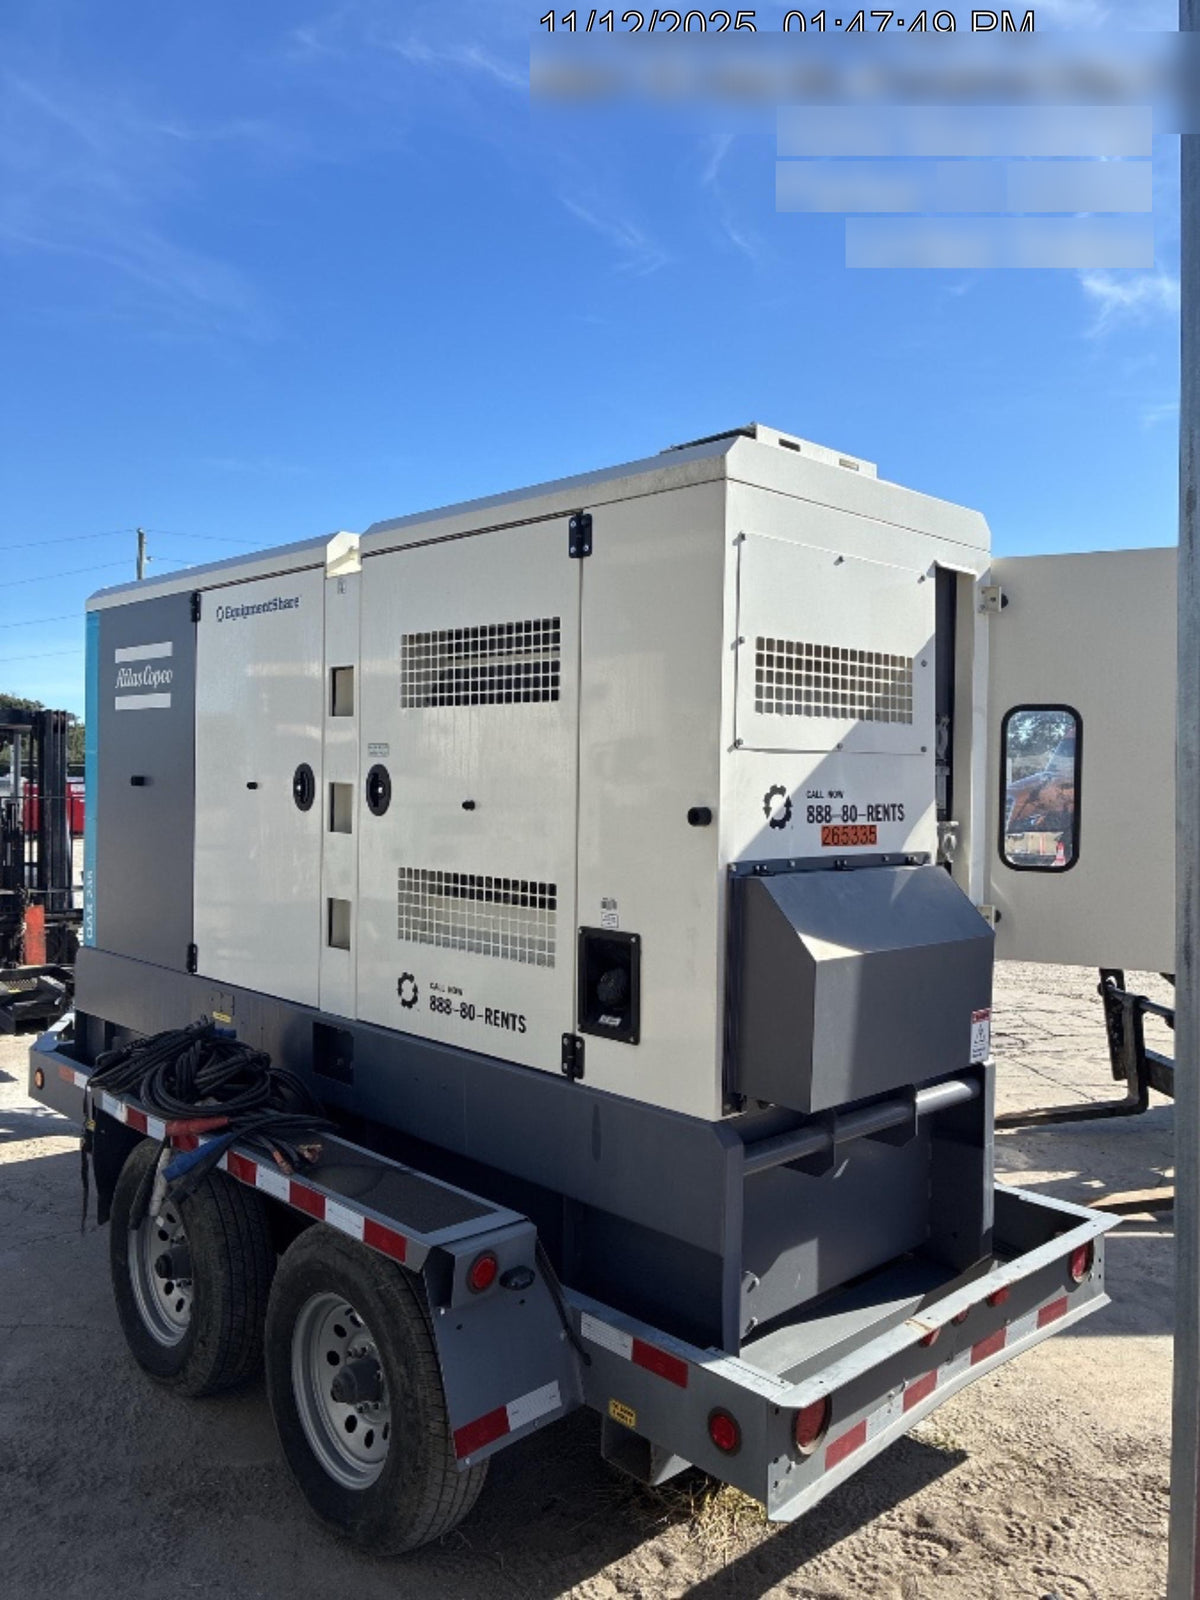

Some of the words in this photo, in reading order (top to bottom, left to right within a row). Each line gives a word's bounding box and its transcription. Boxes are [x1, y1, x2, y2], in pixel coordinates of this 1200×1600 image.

[225, 597, 299, 621] EquipmentShare
[115, 667, 143, 689] Atlas
[143, 664, 173, 689] Copco
[805, 790, 825, 799] CALL
[828, 790, 844, 799] NOW
[806, 803, 905, 823] 888-80-RENTS
[429, 994, 527, 1034] 888-80-RENTS
